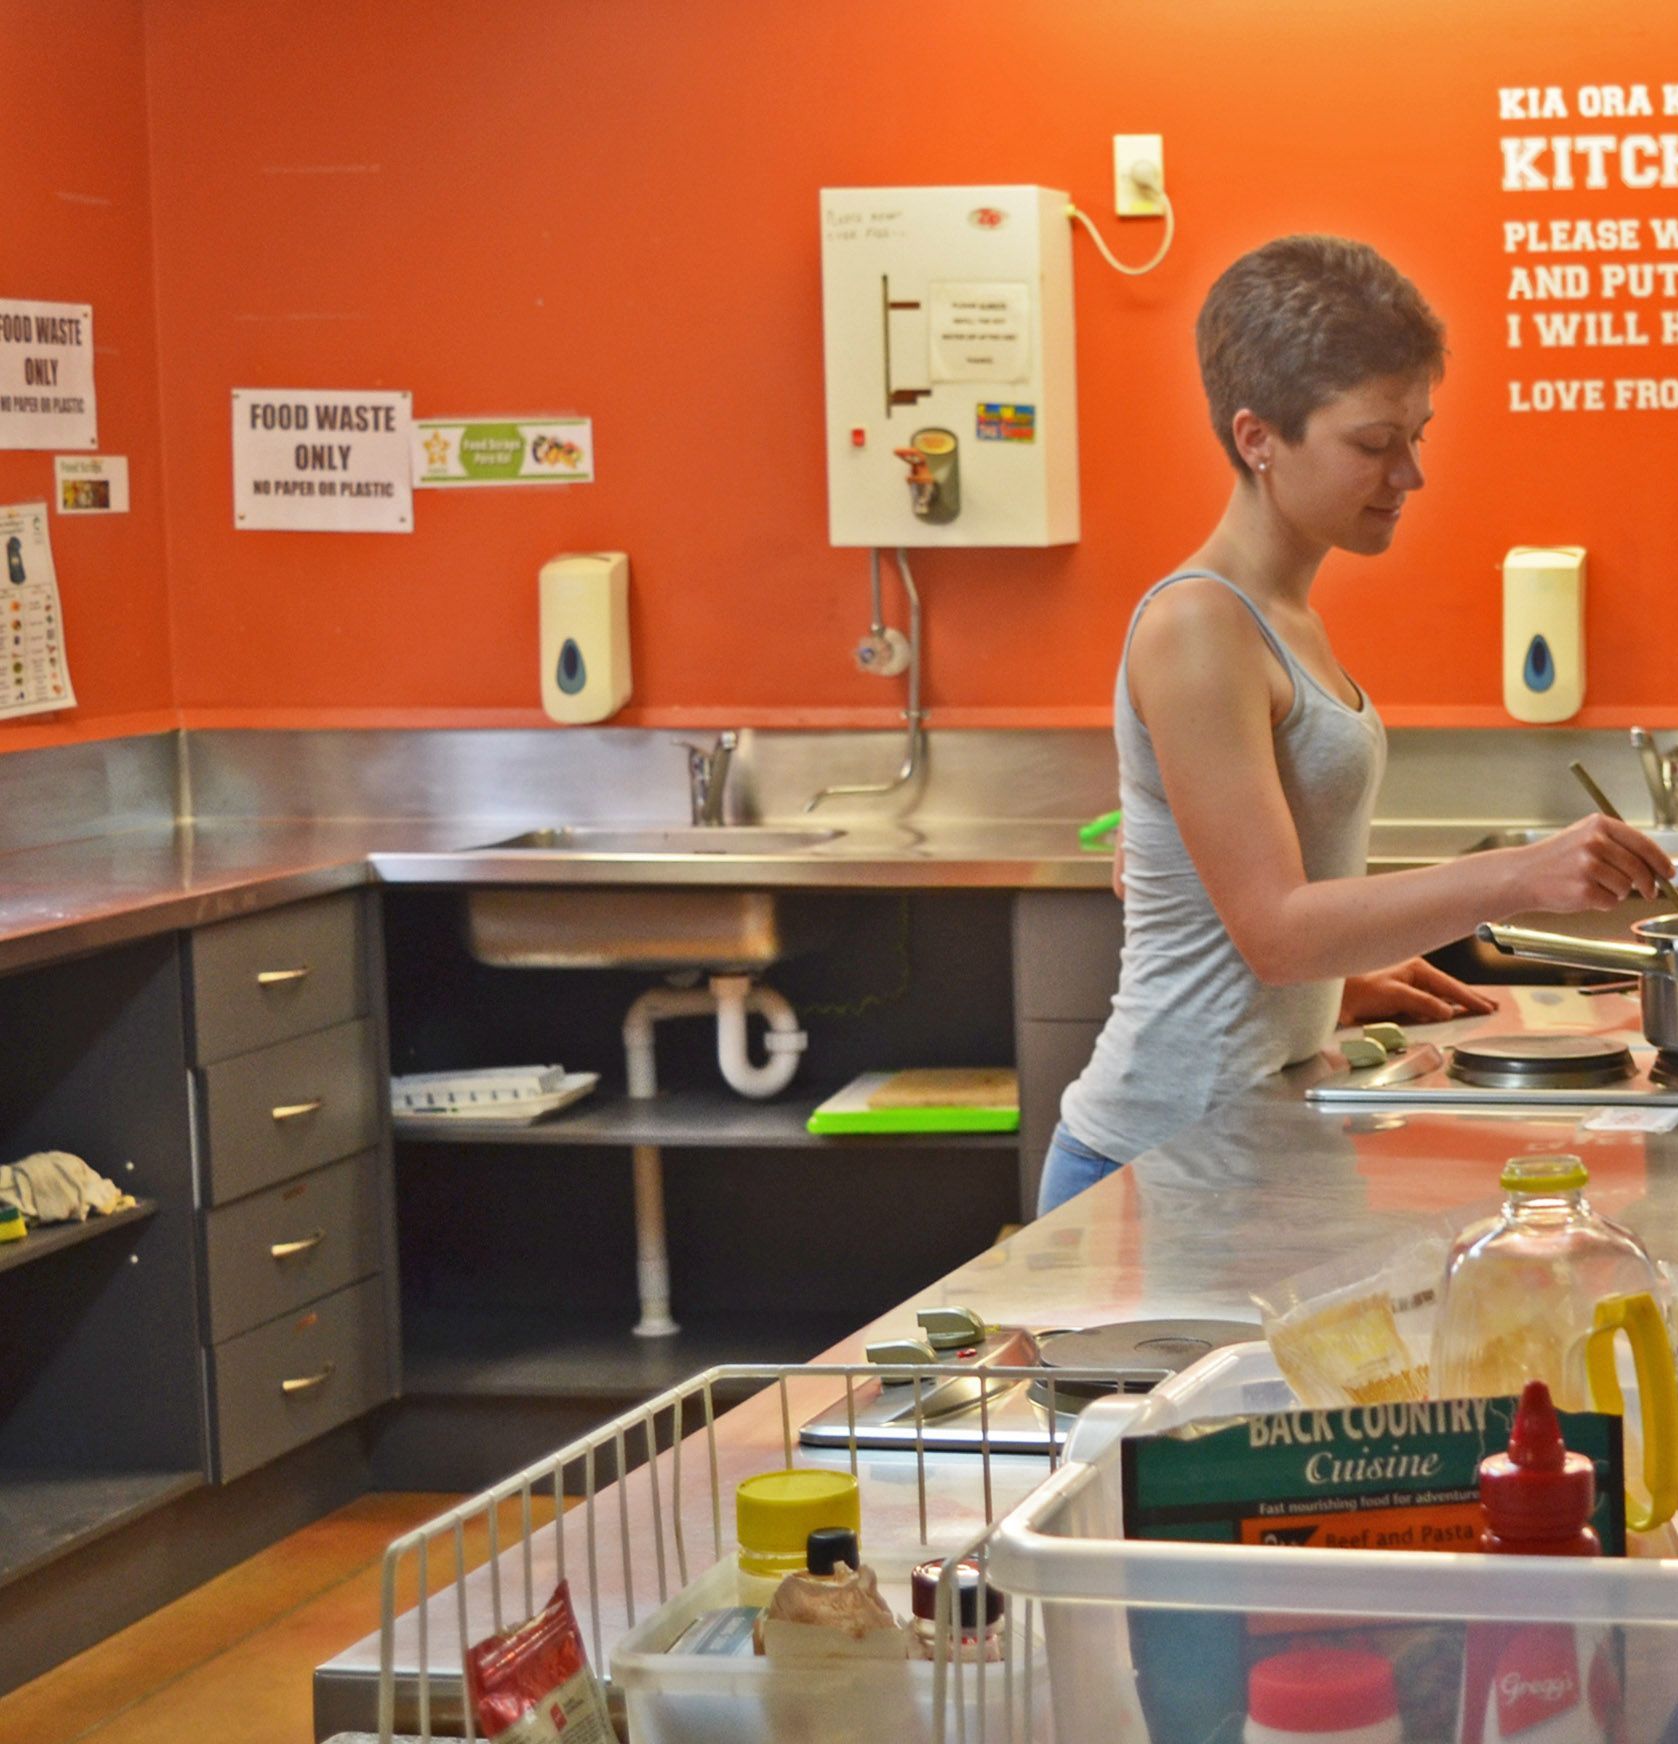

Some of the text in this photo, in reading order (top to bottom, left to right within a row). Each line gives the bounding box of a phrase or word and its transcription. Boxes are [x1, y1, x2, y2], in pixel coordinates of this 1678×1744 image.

[1499, 86, 1568, 120] KIA
[1578, 84, 1653, 117] ORA
[1503, 219, 1640, 253] PLEASE
[1507, 265, 1589, 300] AND
[35, 316, 82, 346] WASTE
[1507, 314, 1521, 348] I
[1533, 312, 1649, 346] WILL
[24, 357, 59, 387] ONLY
[14, 396, 38, 413] PAPER
[53, 397, 85, 414] PLASTIC
[1509, 380, 1604, 412] LOVE
[249, 403, 396, 433] FOOD WASTE
[294, 444, 352, 472] ONLY
[252, 480, 395, 499] NO PAPER OR PLASTIC
[1248, 1399, 1489, 1448] BACK COUNTRY
[1305, 1445, 1445, 1485] Cuisine
[1258, 1502, 1286, 1516] Fast
[1288, 1496, 1358, 1515] nourishing
[1360, 1493, 1390, 1508] food
[1393, 1492, 1413, 1506] for
[1325, 1530, 1370, 1548] Beef
[1376, 1526, 1414, 1546] and
[1421, 1522, 1475, 1542] Pasta
